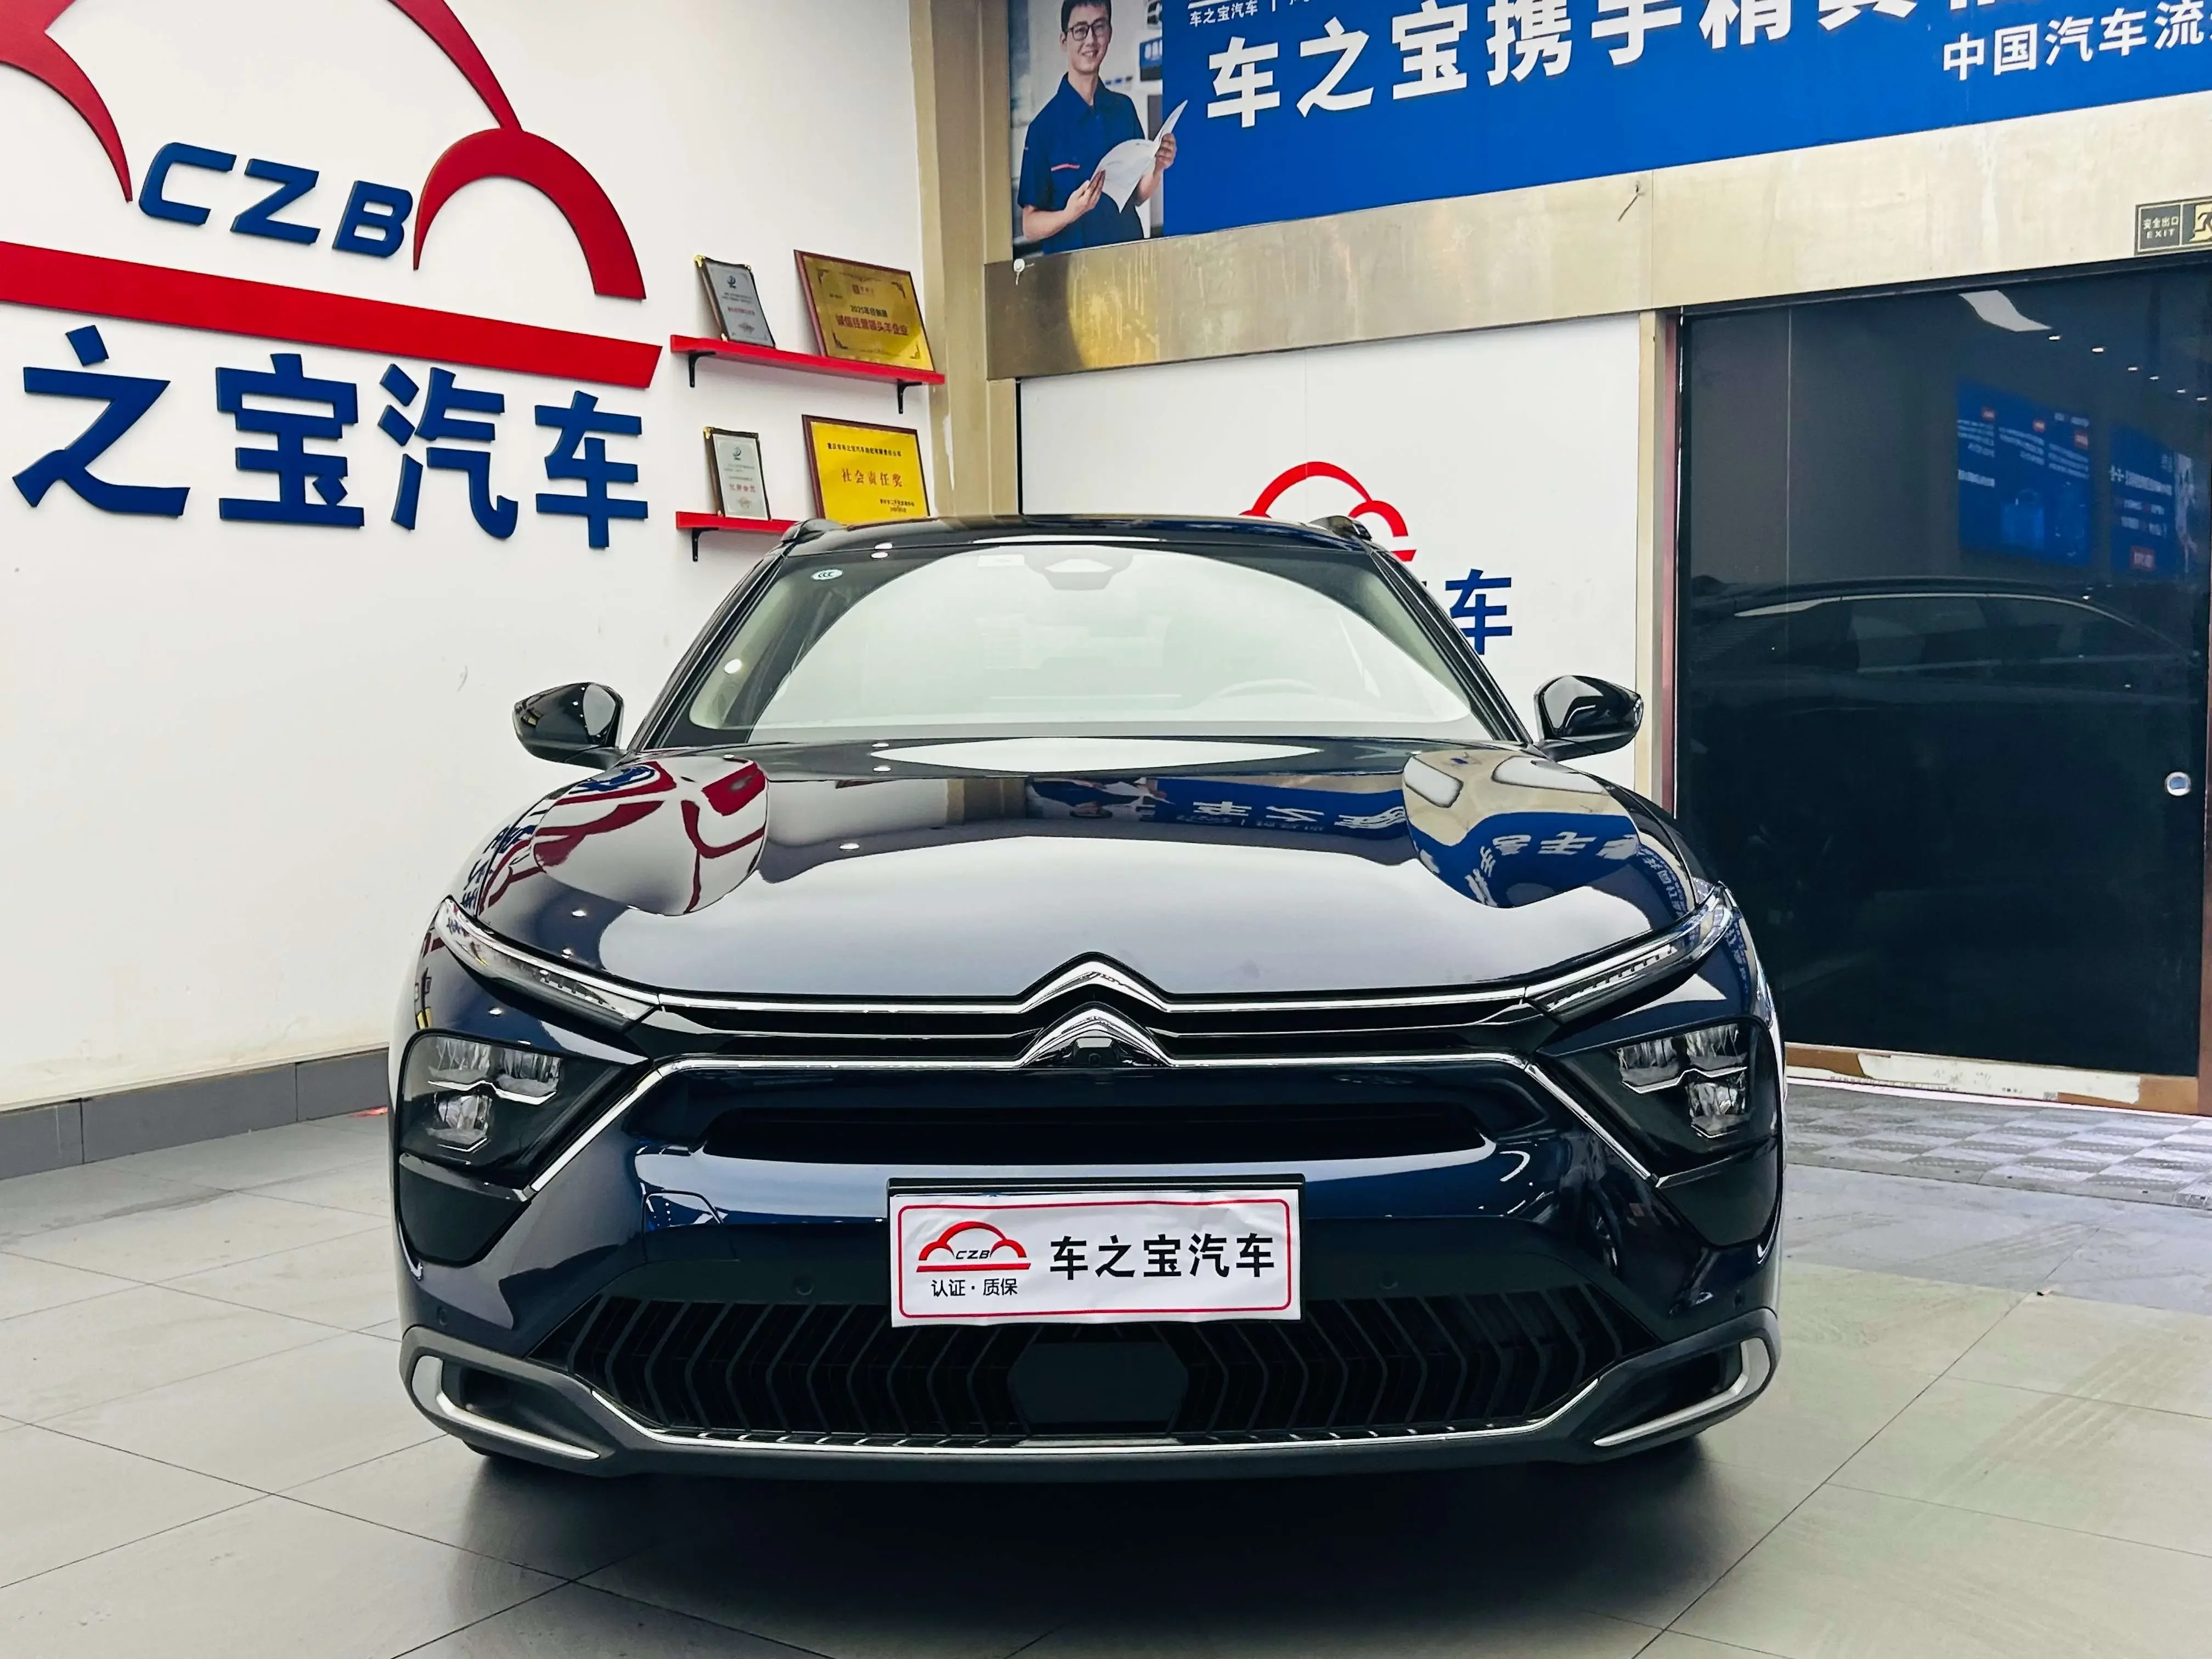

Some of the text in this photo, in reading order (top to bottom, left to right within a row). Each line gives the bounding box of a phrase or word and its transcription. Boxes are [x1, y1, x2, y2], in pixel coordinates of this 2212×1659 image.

[1189, 0, 1258, 27] 车之宝汽车
[1943, 0, 2212, 81] 中国汽车流
[1207, 0, 1995, 128] 车之宝携手
[139, 142, 413, 258] CZB
[2143, 216, 2179, 230] 安全出口
[2146, 228, 2175, 239] EXIT
[12, 324, 648, 549] 之宝汽车
[842, 468, 902, 488] 社会责任奖
[956, 1250, 990, 1260] CZB
[1049, 1233, 1274, 1280] 车之宝汽车
